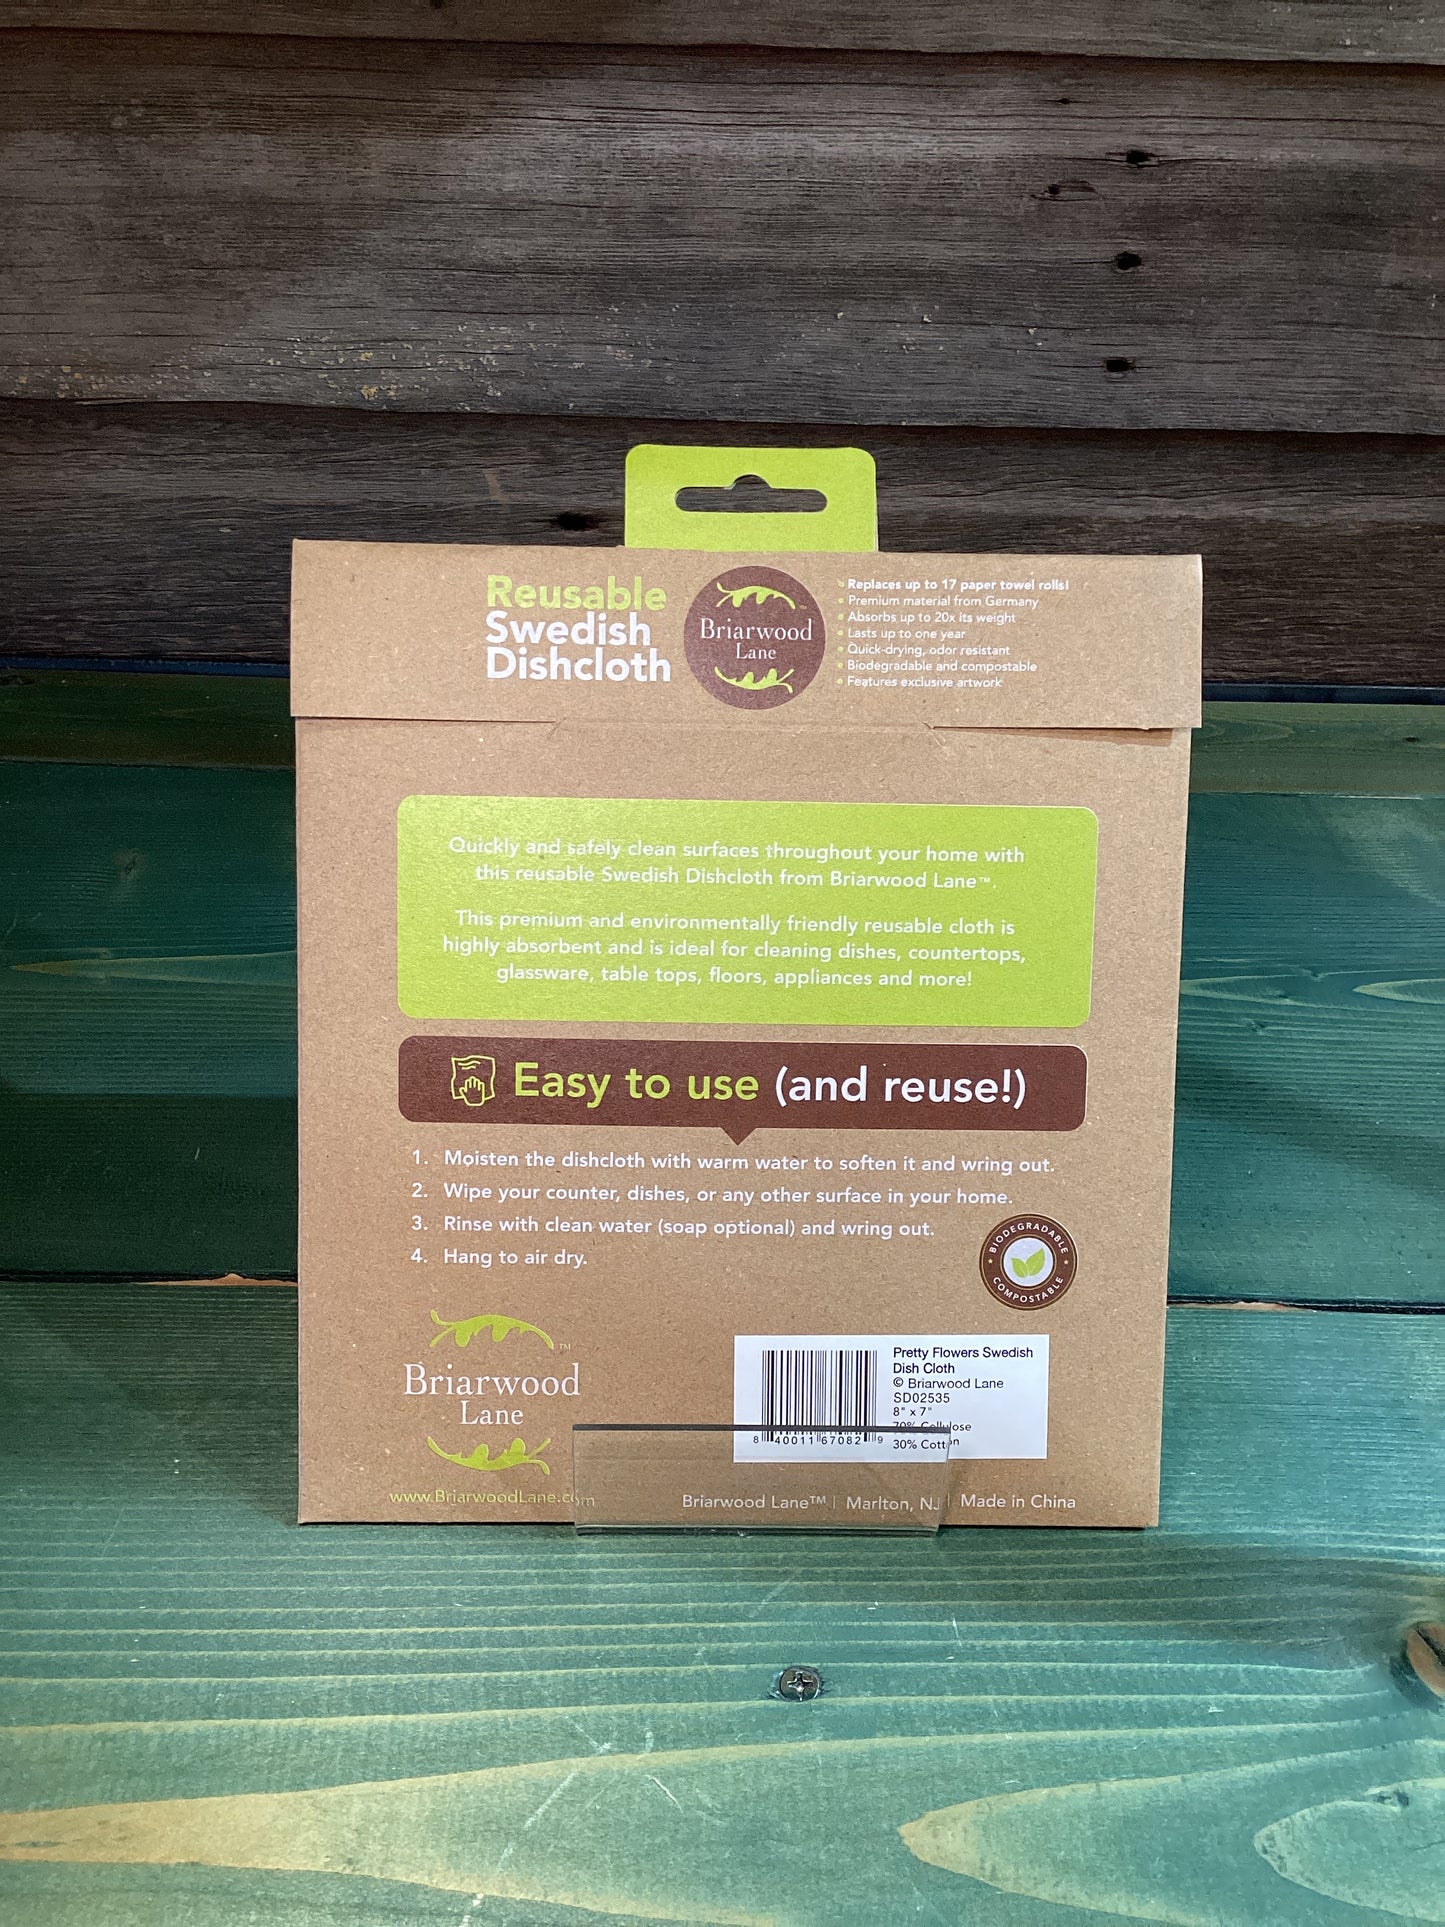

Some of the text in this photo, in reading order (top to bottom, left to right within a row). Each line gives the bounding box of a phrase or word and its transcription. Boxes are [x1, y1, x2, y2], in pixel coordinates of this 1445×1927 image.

[487, 575, 666, 610] Reusable
[848, 579, 1069, 592] Replaces up to 17 paper towel rolls!
[848, 596, 1039, 610] Premium material from Germany
[486, 611, 649, 646] Swedish
[700, 618, 812, 641] Briarwood
[848, 612, 1015, 626] Absorbs up to 20x its weight
[848, 629, 877, 638] Lasts
[881, 631, 895, 641] up
[899, 630, 911, 638] to
[941, 631, 965, 641] year
[736, 642, 776, 660] Lane
[848, 645, 1010, 657] Quick-drying, odor resistant
[487, 647, 671, 681] Dishcloth
[848, 661, 1037, 674] Biodegradable and compostable
[848, 677, 1002, 687] Features exclusive artwork
[450, 836, 1024, 864] Quickly and safely clean surfaces throughout your home with
[476, 865, 509, 881] this
[516, 865, 594, 881] reusable
[601, 866, 679, 883] Swedish
[687, 867, 773, 884] Dishcloth
[780, 869, 823, 886] from
[831, 871, 927, 888] Briarwood
[456, 910, 1015, 936] This premium and environmentally friendly reusable cloth is
[443, 936, 1026, 965] highly absorbent and is ideal for cleaning dishes, countertops,
[497, 964, 972, 988] glassware, table tops, floors, appliances and more!
[515, 1062, 1025, 1110] Easy to use (and reuse!)
[412, 1150, 1055, 1175] 1. Moisten the dishcloth with warm water to soften it and wring out.
[412, 1183, 1013, 1207] 2. Wipe your counter, dishes, or any other surface in your home.
[412, 1216, 934, 1240] 3. Rinse with clean water (soap optional) and wring out.
[989, 1222, 1068, 1254] BIODEGRADABLE
[411, 1249, 587, 1268] 4. Hang to air dry.
[993, 1277, 1063, 1303] COMPOSTABLE
[893, 1347, 1033, 1360] Pretty Flowers Swedish
[404, 1362, 580, 1395] Briarwood
[893, 1363, 955, 1373] Dish Cloth
[908, 1378, 970, 1389] Briarwood
[975, 1379, 1003, 1388] Lane
[893, 1393, 950, 1403] SD02535
[460, 1400, 523, 1424] Lane
[893, 1440, 917, 1449] 30%
[683, 1494, 765, 1508] Briarwood
[846, 1496, 913, 1512] Marlton,
[920, 1497, 940, 1511] NJ
[961, 1494, 1006, 1508] Made
[1012, 1495, 1024, 1508] in
[1031, 1494, 1076, 1508] China
